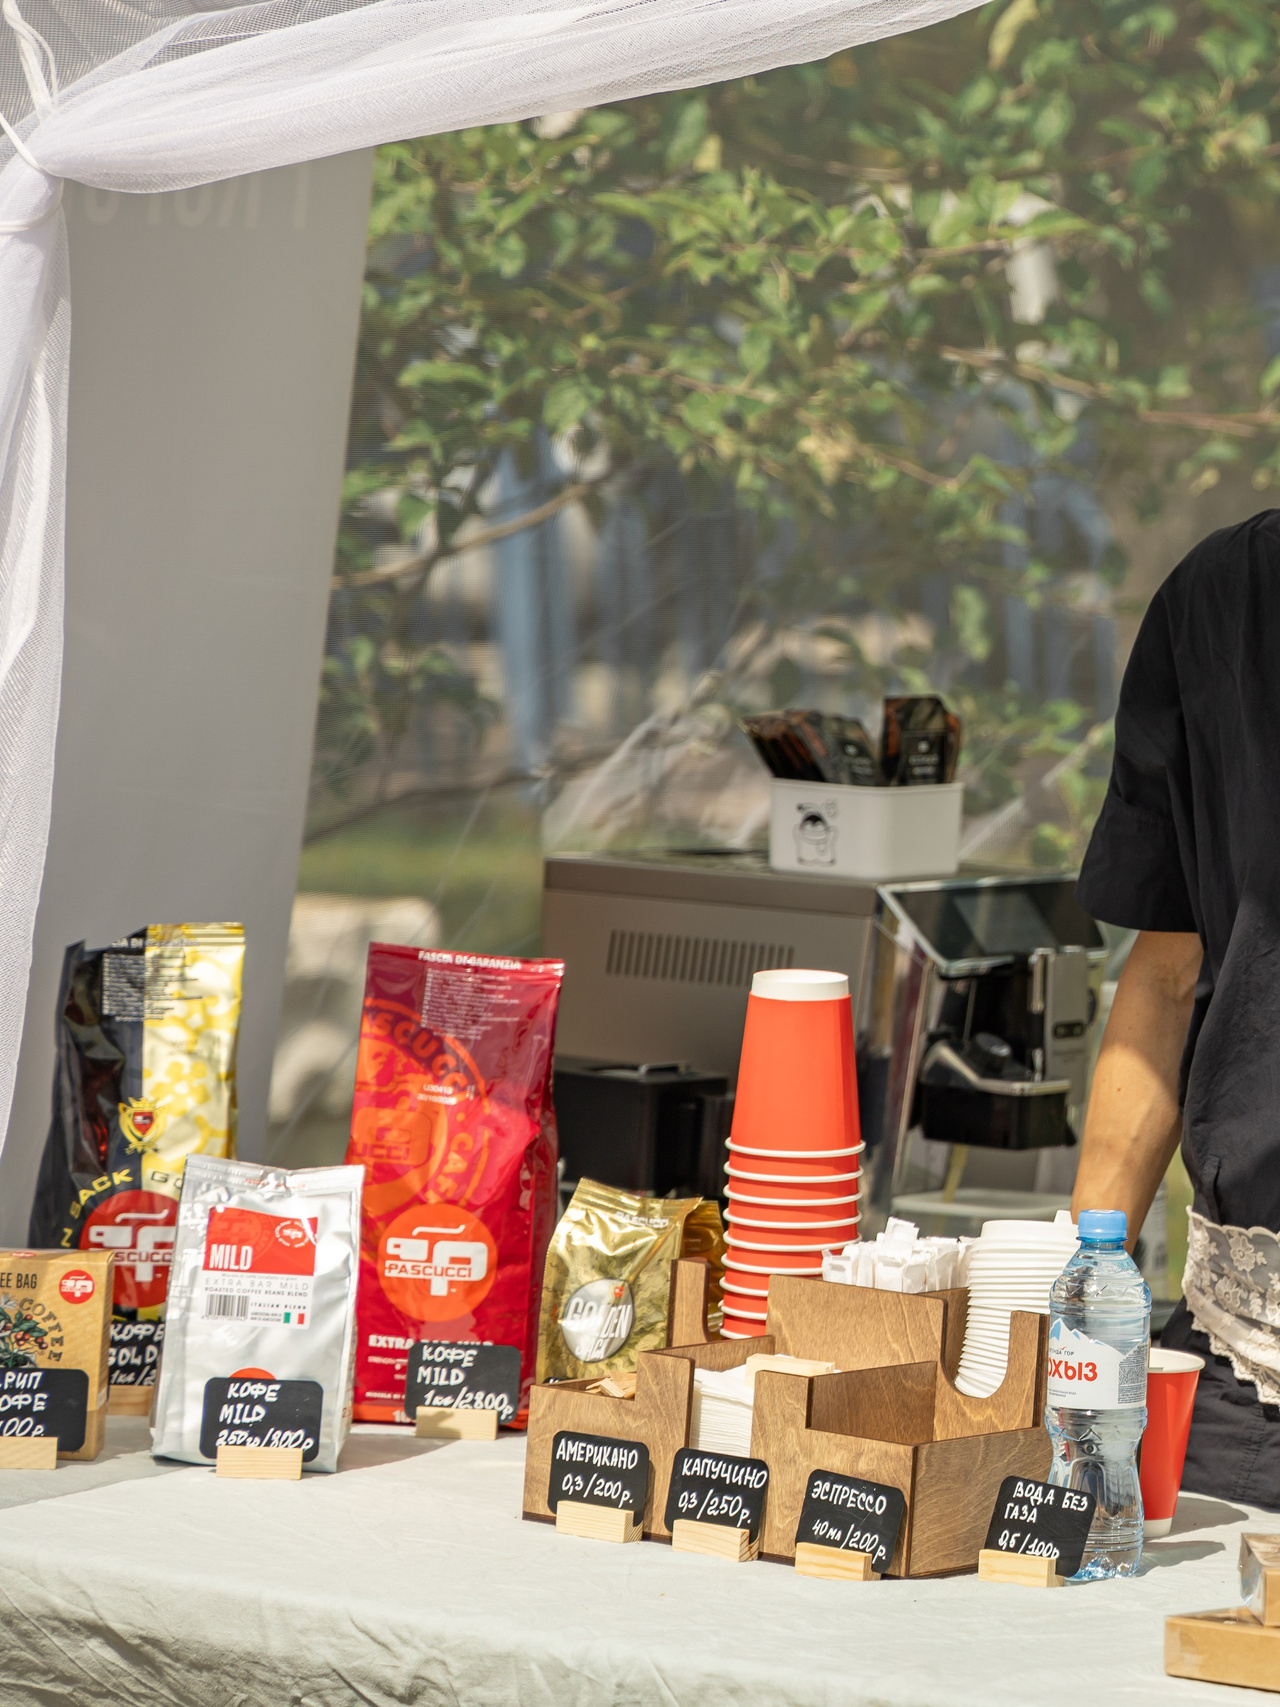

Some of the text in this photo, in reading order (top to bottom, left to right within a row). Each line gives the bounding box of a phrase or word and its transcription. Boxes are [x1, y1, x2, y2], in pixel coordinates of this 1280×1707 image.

[113, 1251, 174, 1263] SCUCC
[209, 1243, 253, 1271] MILD
[16, 1273, 38, 1289] BAG
[386, 1261, 472, 1280] PASCUCCI
[205, 1278, 309, 1291] EXTRA BAR MILD
[19, 1297, 64, 1362] COFFEE
[368, 1334, 415, 1350] EXTRA
[422, 1344, 478, 1368] КОФЕ
[0, 1371, 43, 1390] РИП
[416, 1366, 466, 1387] MILD
[0, 1392, 48, 1412] ОФЕ
[227, 1382, 282, 1402] КОФЕ
[219, 1403, 267, 1425] MILD
[556, 1438, 639, 1470] АМЕРИКАНО
[682, 1457, 768, 1490] КАПУЧИНО
[811, 1480, 887, 1516] ЭСПРЕССО
[1013, 1481, 1088, 1512] ВОДА БЕЗ
[1004, 1503, 1037, 1524] ГАЗА
